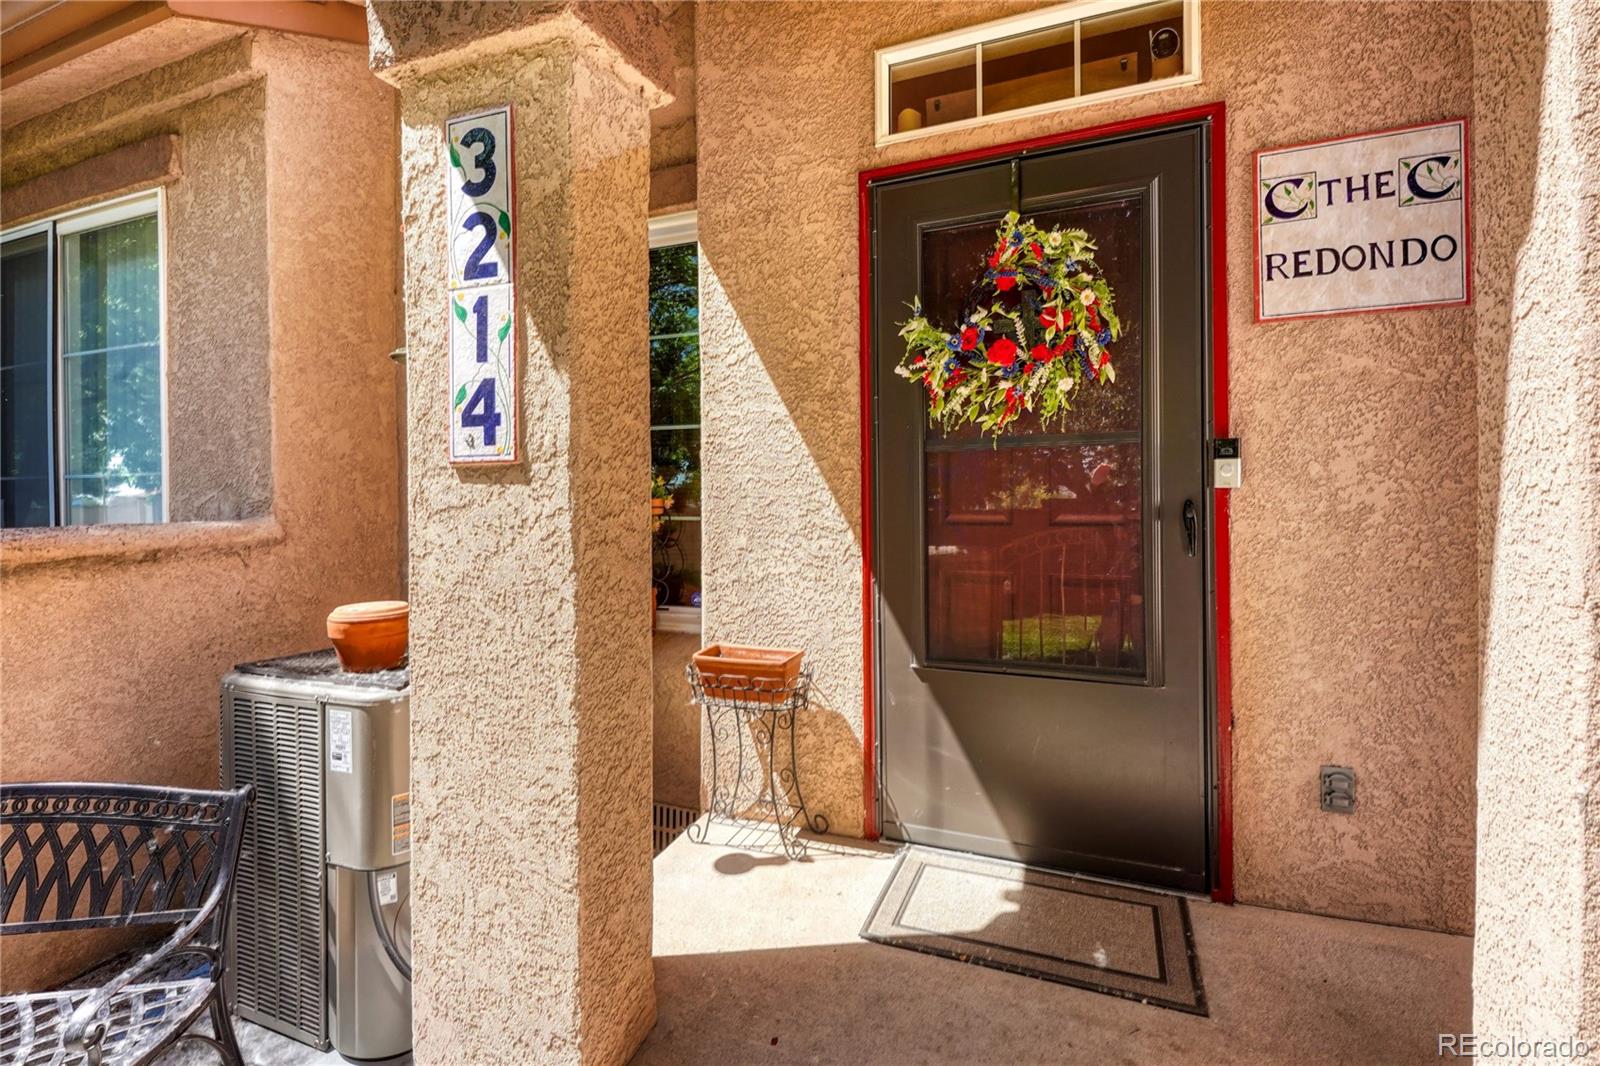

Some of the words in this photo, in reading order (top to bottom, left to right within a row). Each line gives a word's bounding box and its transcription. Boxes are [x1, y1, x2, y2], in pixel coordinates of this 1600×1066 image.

[1318, 170, 1396, 207] THE
[1265, 234, 1458, 282] REDONDO
[460, 127, 502, 446] 3214
